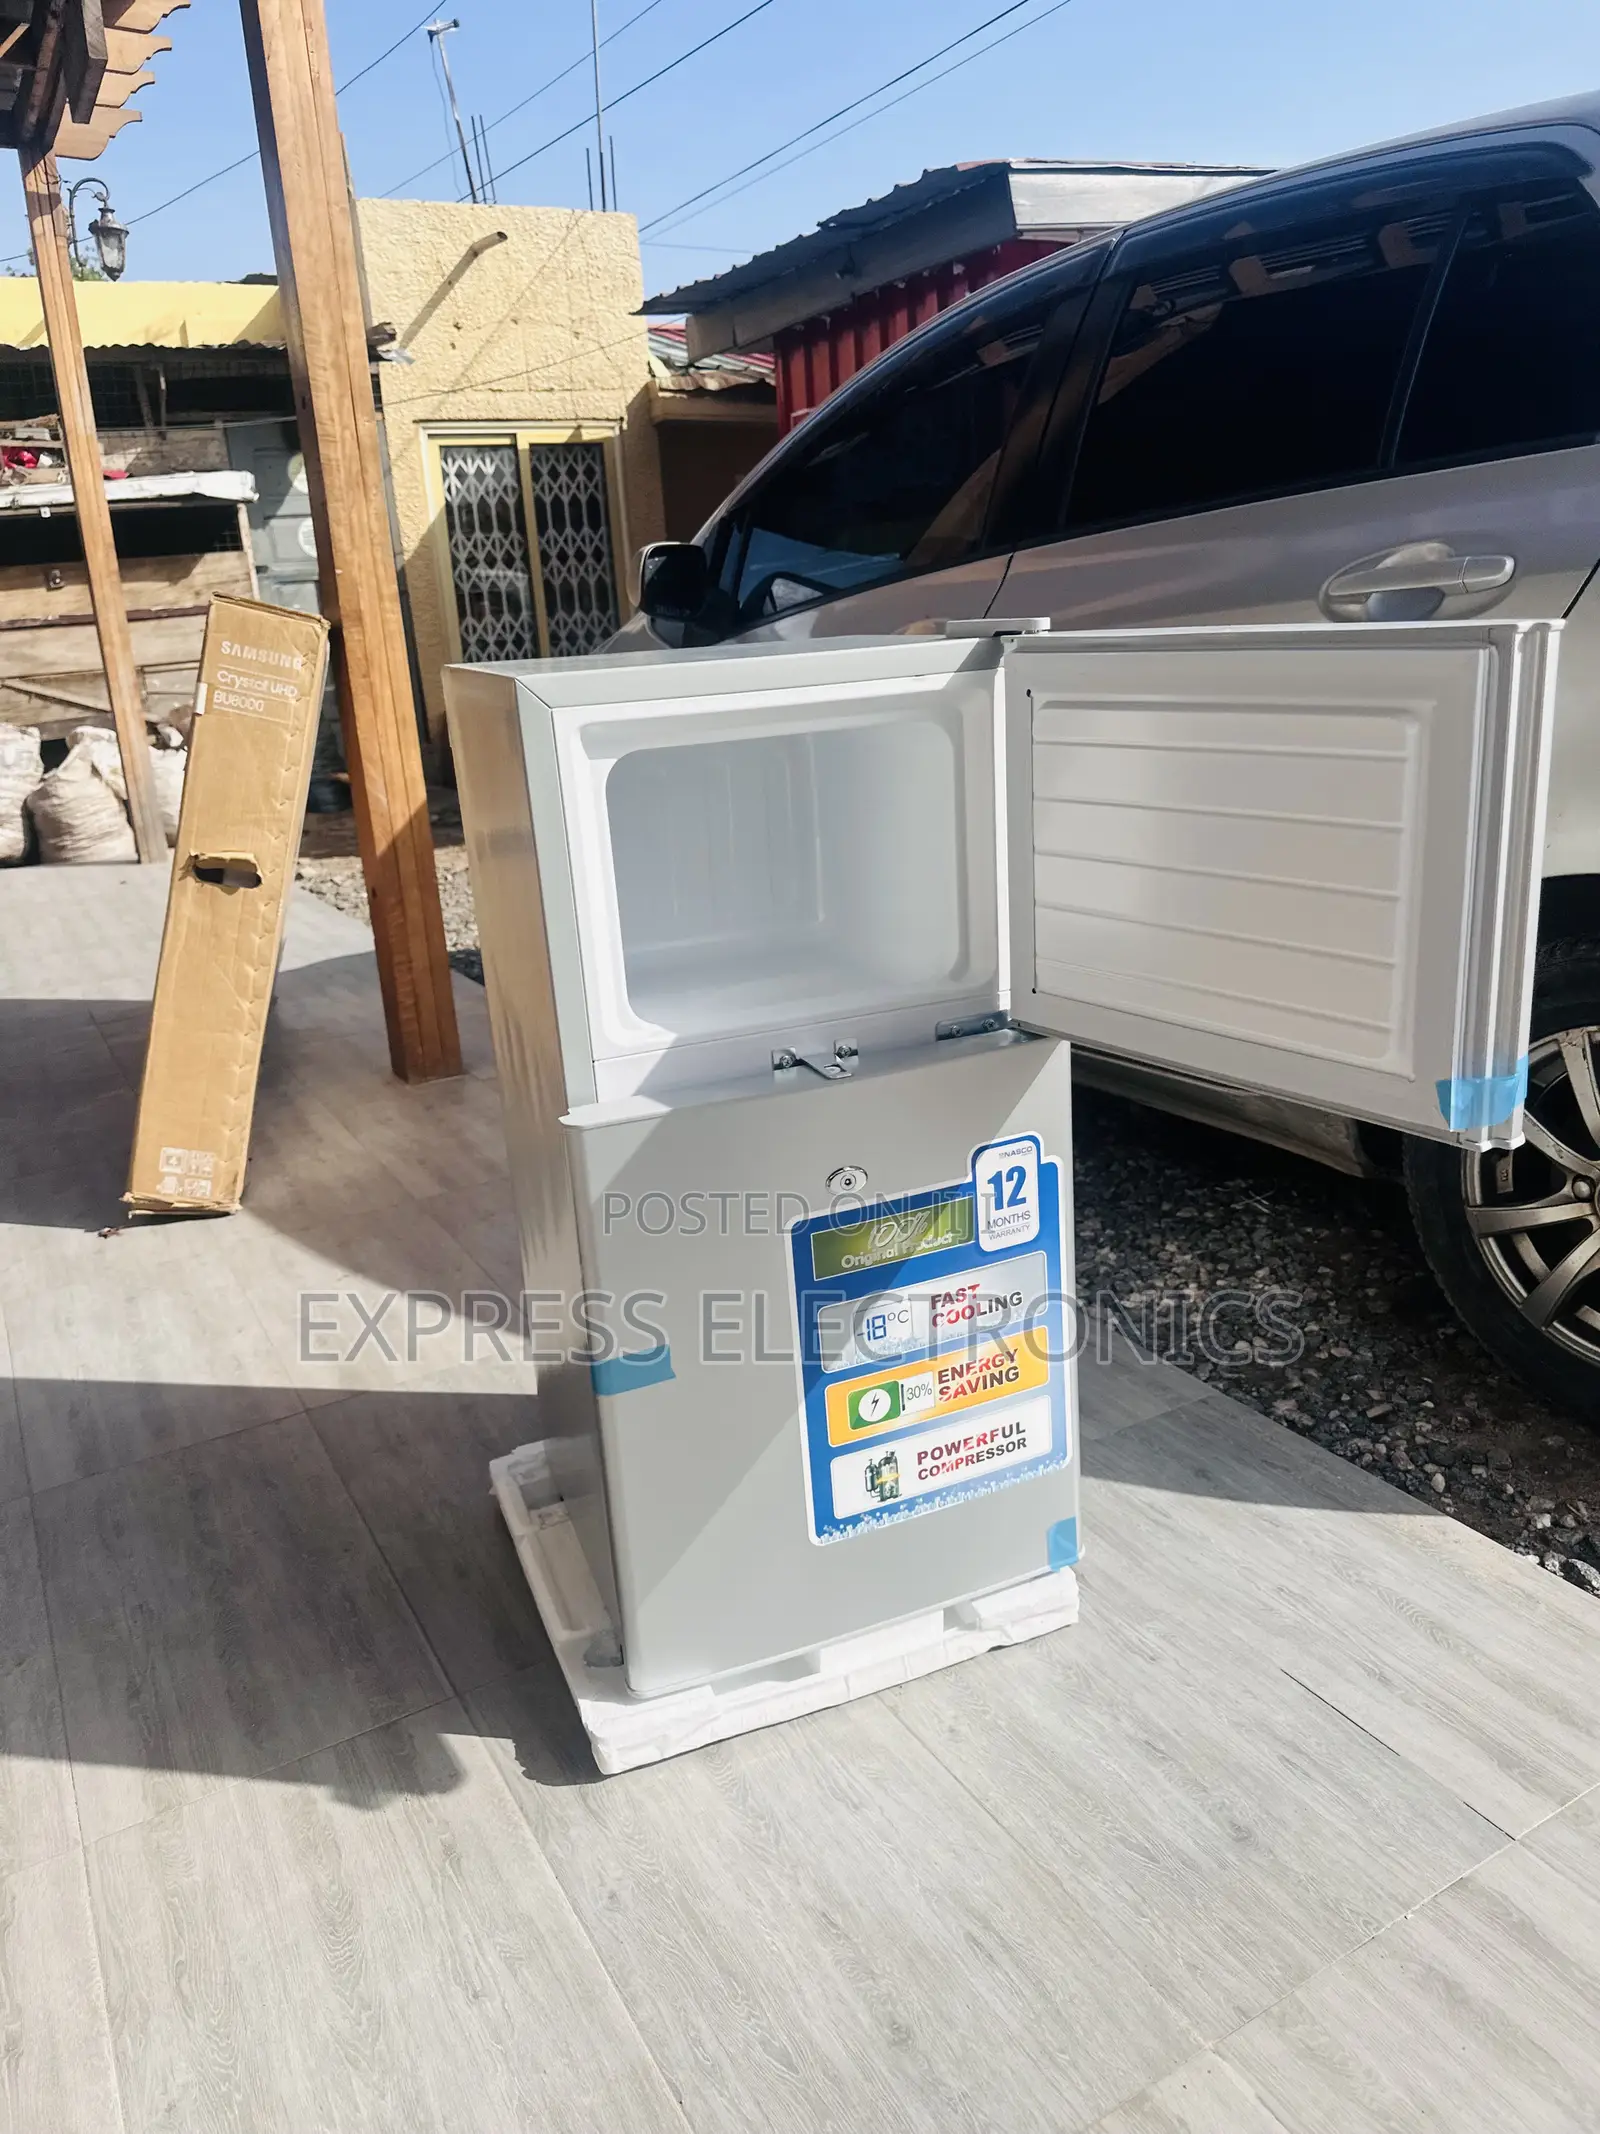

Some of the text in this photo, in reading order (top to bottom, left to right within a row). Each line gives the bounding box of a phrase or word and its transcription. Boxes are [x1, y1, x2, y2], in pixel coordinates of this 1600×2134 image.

[220, 640, 303, 671] SAMSUNG
[213, 690, 264, 712] BU8000
[217, 670, 298, 698] Crystal UHD
[1004, 1146, 1033, 1158] NASCO
[987, 1165, 1027, 1211] 12
[867, 1210, 931, 1250] 100%
[988, 1210, 1031, 1231] MONTHS
[989, 1224, 1030, 1241] WARRANTY
[841, 1231, 953, 1269] Original Product
[930, 1284, 981, 1312] FAST
[931, 1291, 1023, 1328] COOLING
[937, 1348, 1019, 1385] ENERGY
[938, 1365, 1020, 1402] SAVING
[906, 1383, 933, 1401] 30%
[917, 1421, 1026, 1465] POWERFUL
[917, 1437, 1027, 1481] COMPRESSOR
